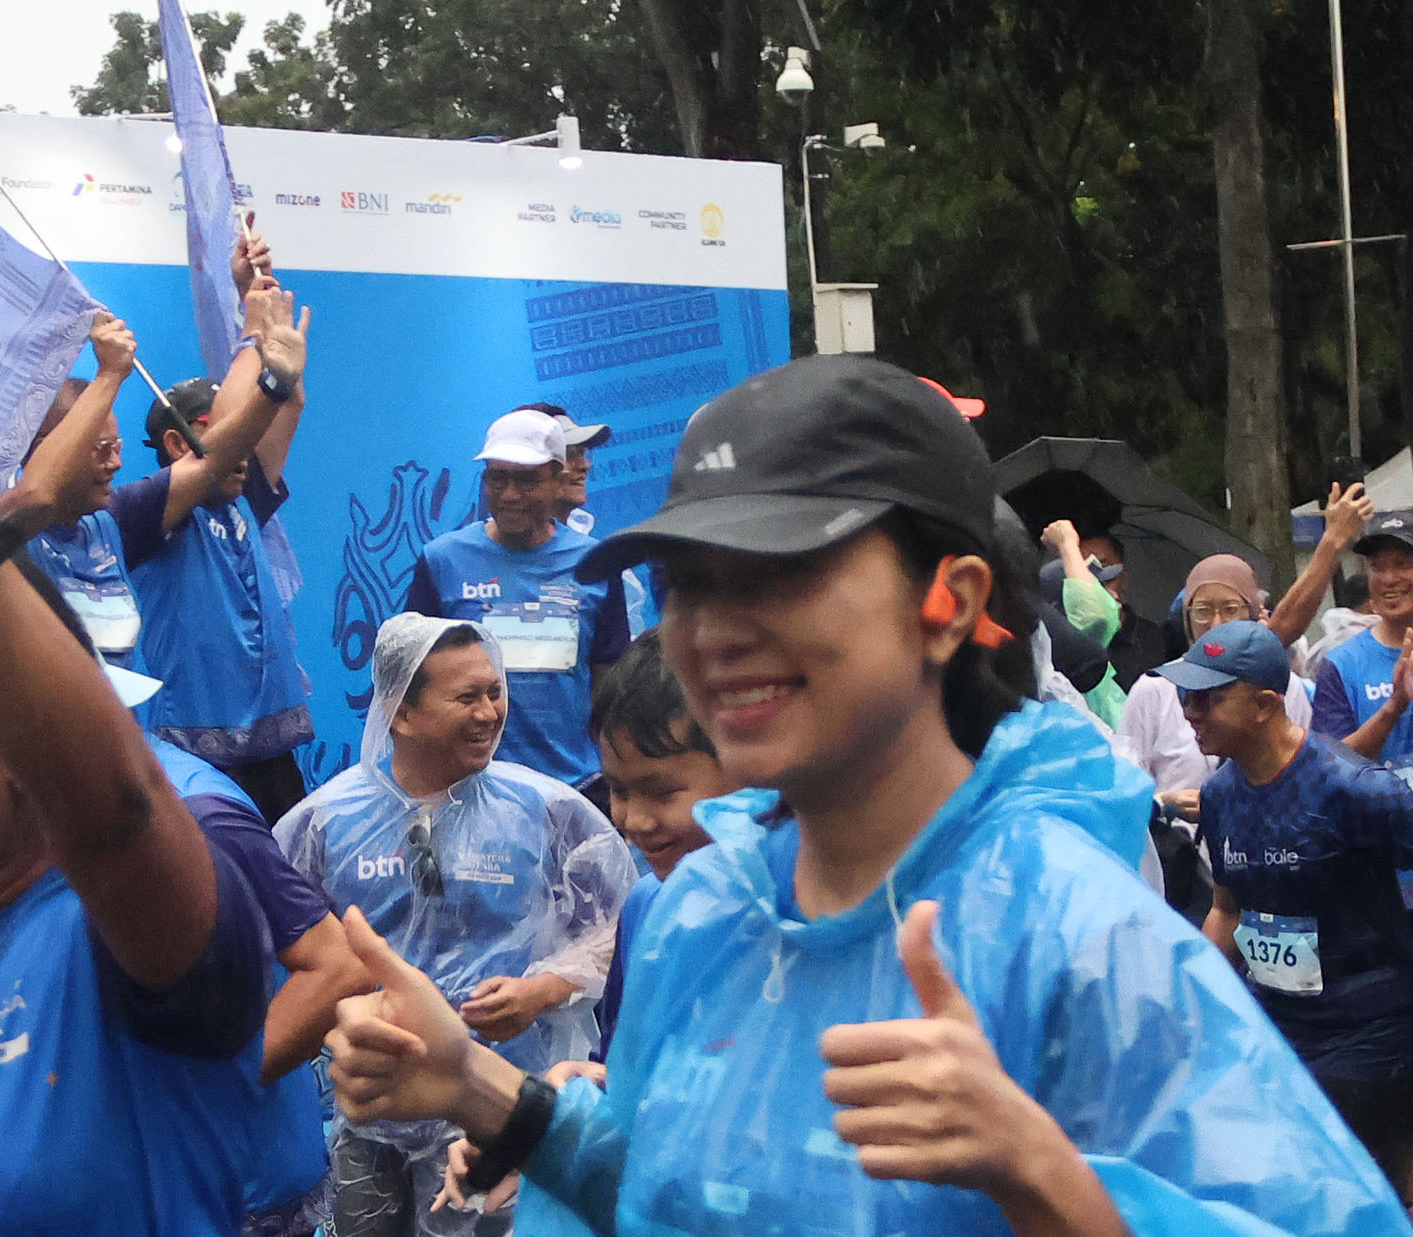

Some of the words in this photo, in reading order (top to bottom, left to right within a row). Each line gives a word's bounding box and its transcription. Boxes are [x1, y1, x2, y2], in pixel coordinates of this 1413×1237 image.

[99, 183, 153, 195] PERTAMINA
[276, 192, 321, 208] mizone
[358, 191, 389, 212] BNI
[462, 581, 501, 599] btn
[358, 854, 405, 880] btn
[1247, 938, 1297, 967] 1376
